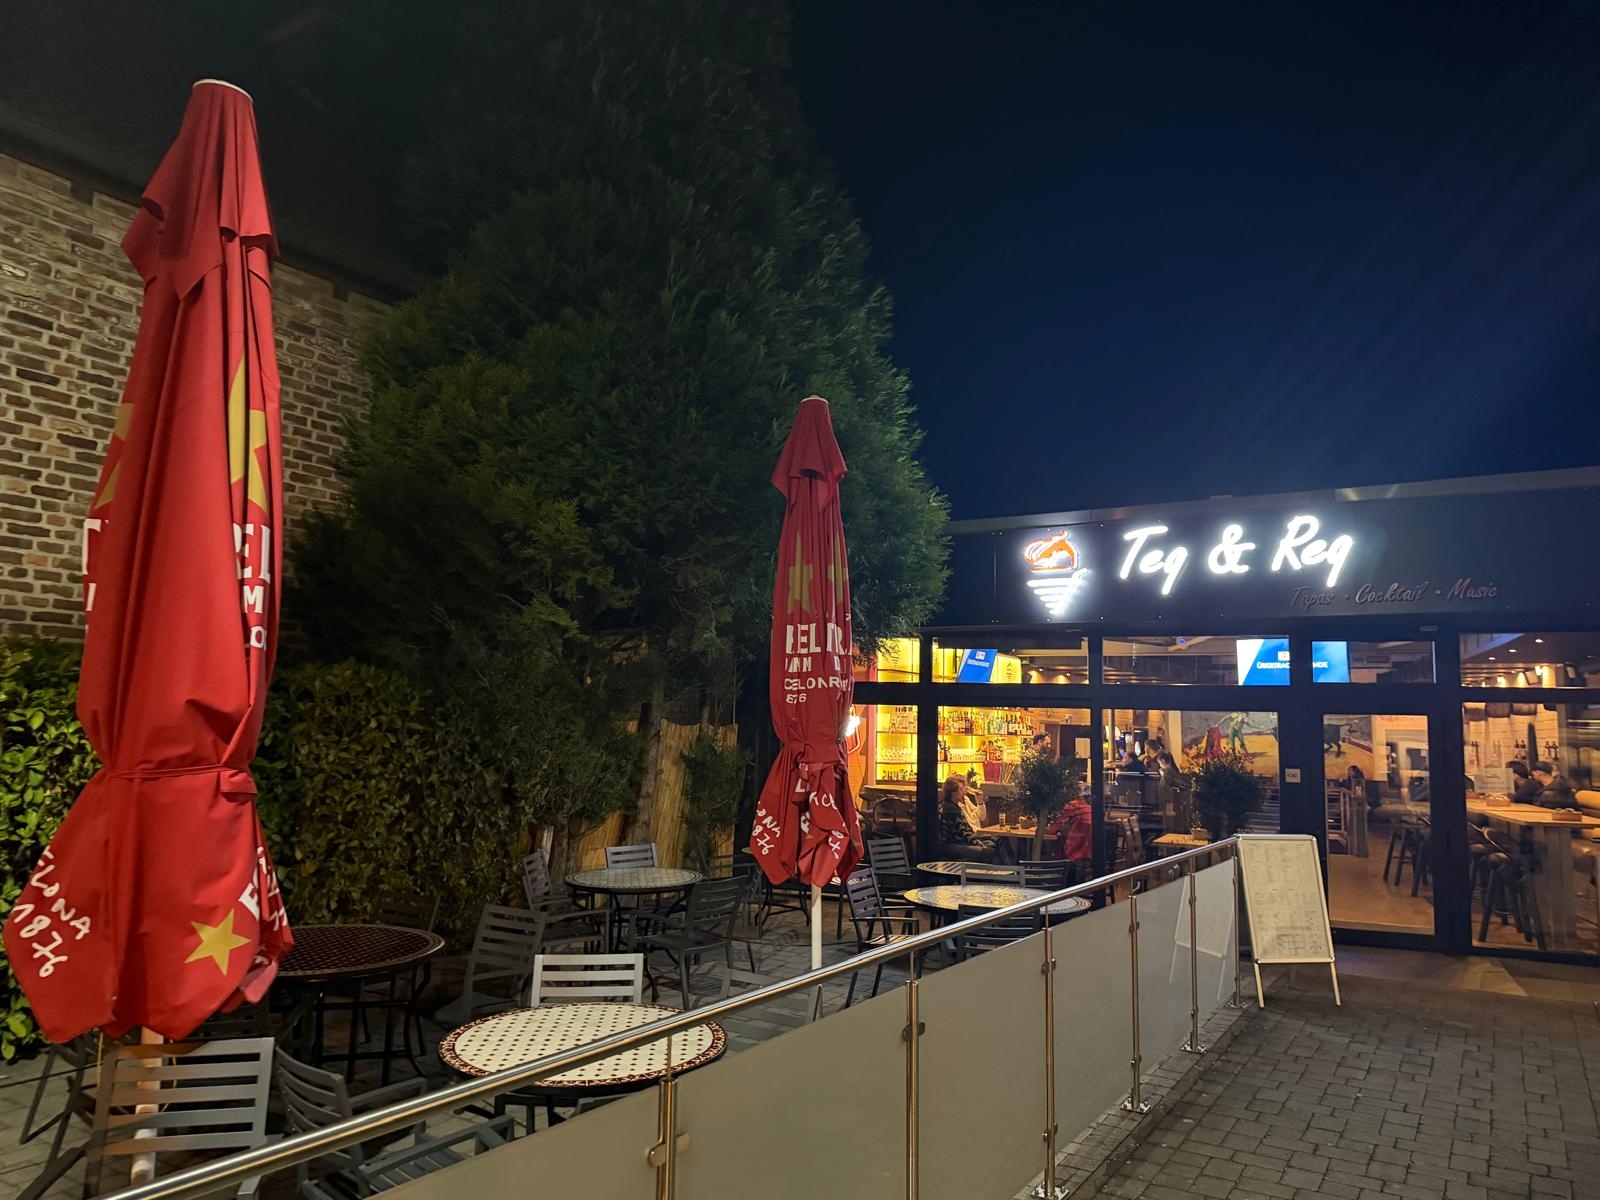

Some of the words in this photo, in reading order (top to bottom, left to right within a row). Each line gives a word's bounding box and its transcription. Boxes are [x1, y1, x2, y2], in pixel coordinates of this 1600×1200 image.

[1119, 525, 1188, 595] Teq
[1208, 524, 1256, 574] &
[1271, 515, 1353, 587] Req
[1290, 585, 1335, 612] Tapas
[1355, 580, 1430, 604] Cocktail
[1447, 578, 1499, 599] Music
[11, 903, 68, 978] 1876
